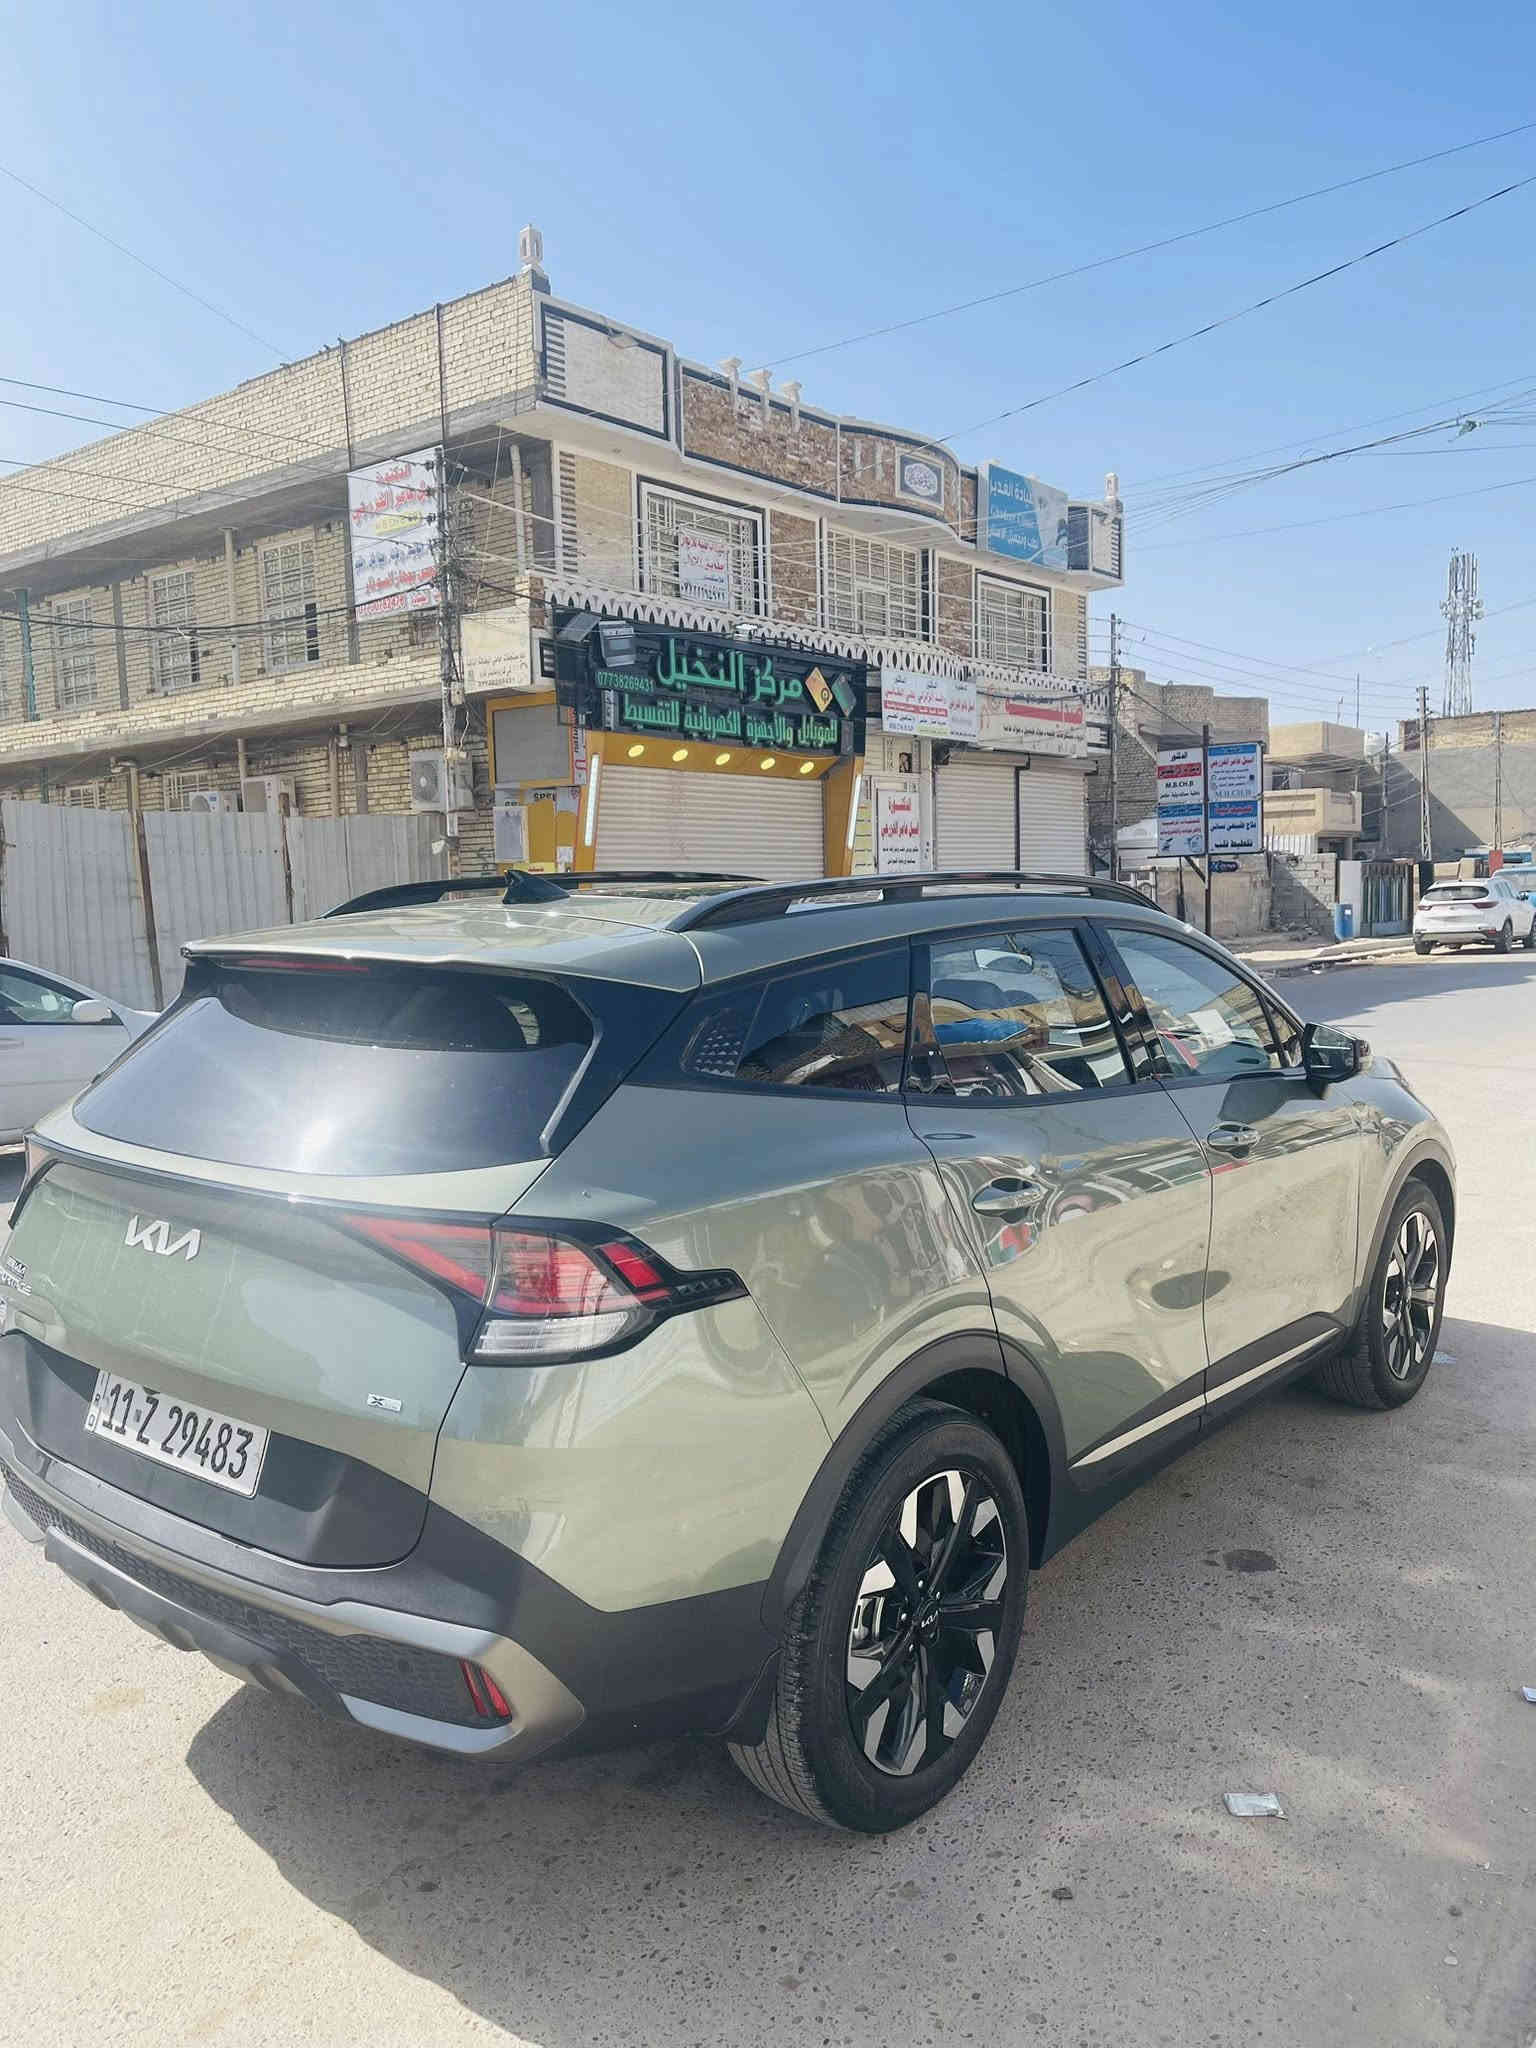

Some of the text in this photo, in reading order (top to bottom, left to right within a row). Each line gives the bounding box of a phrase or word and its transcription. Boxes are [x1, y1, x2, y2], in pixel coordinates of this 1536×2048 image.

[656, 638, 803, 704] مركز النخيل
[124, 1215, 201, 1262] KIA
[160, 1405, 254, 1480] 29483
